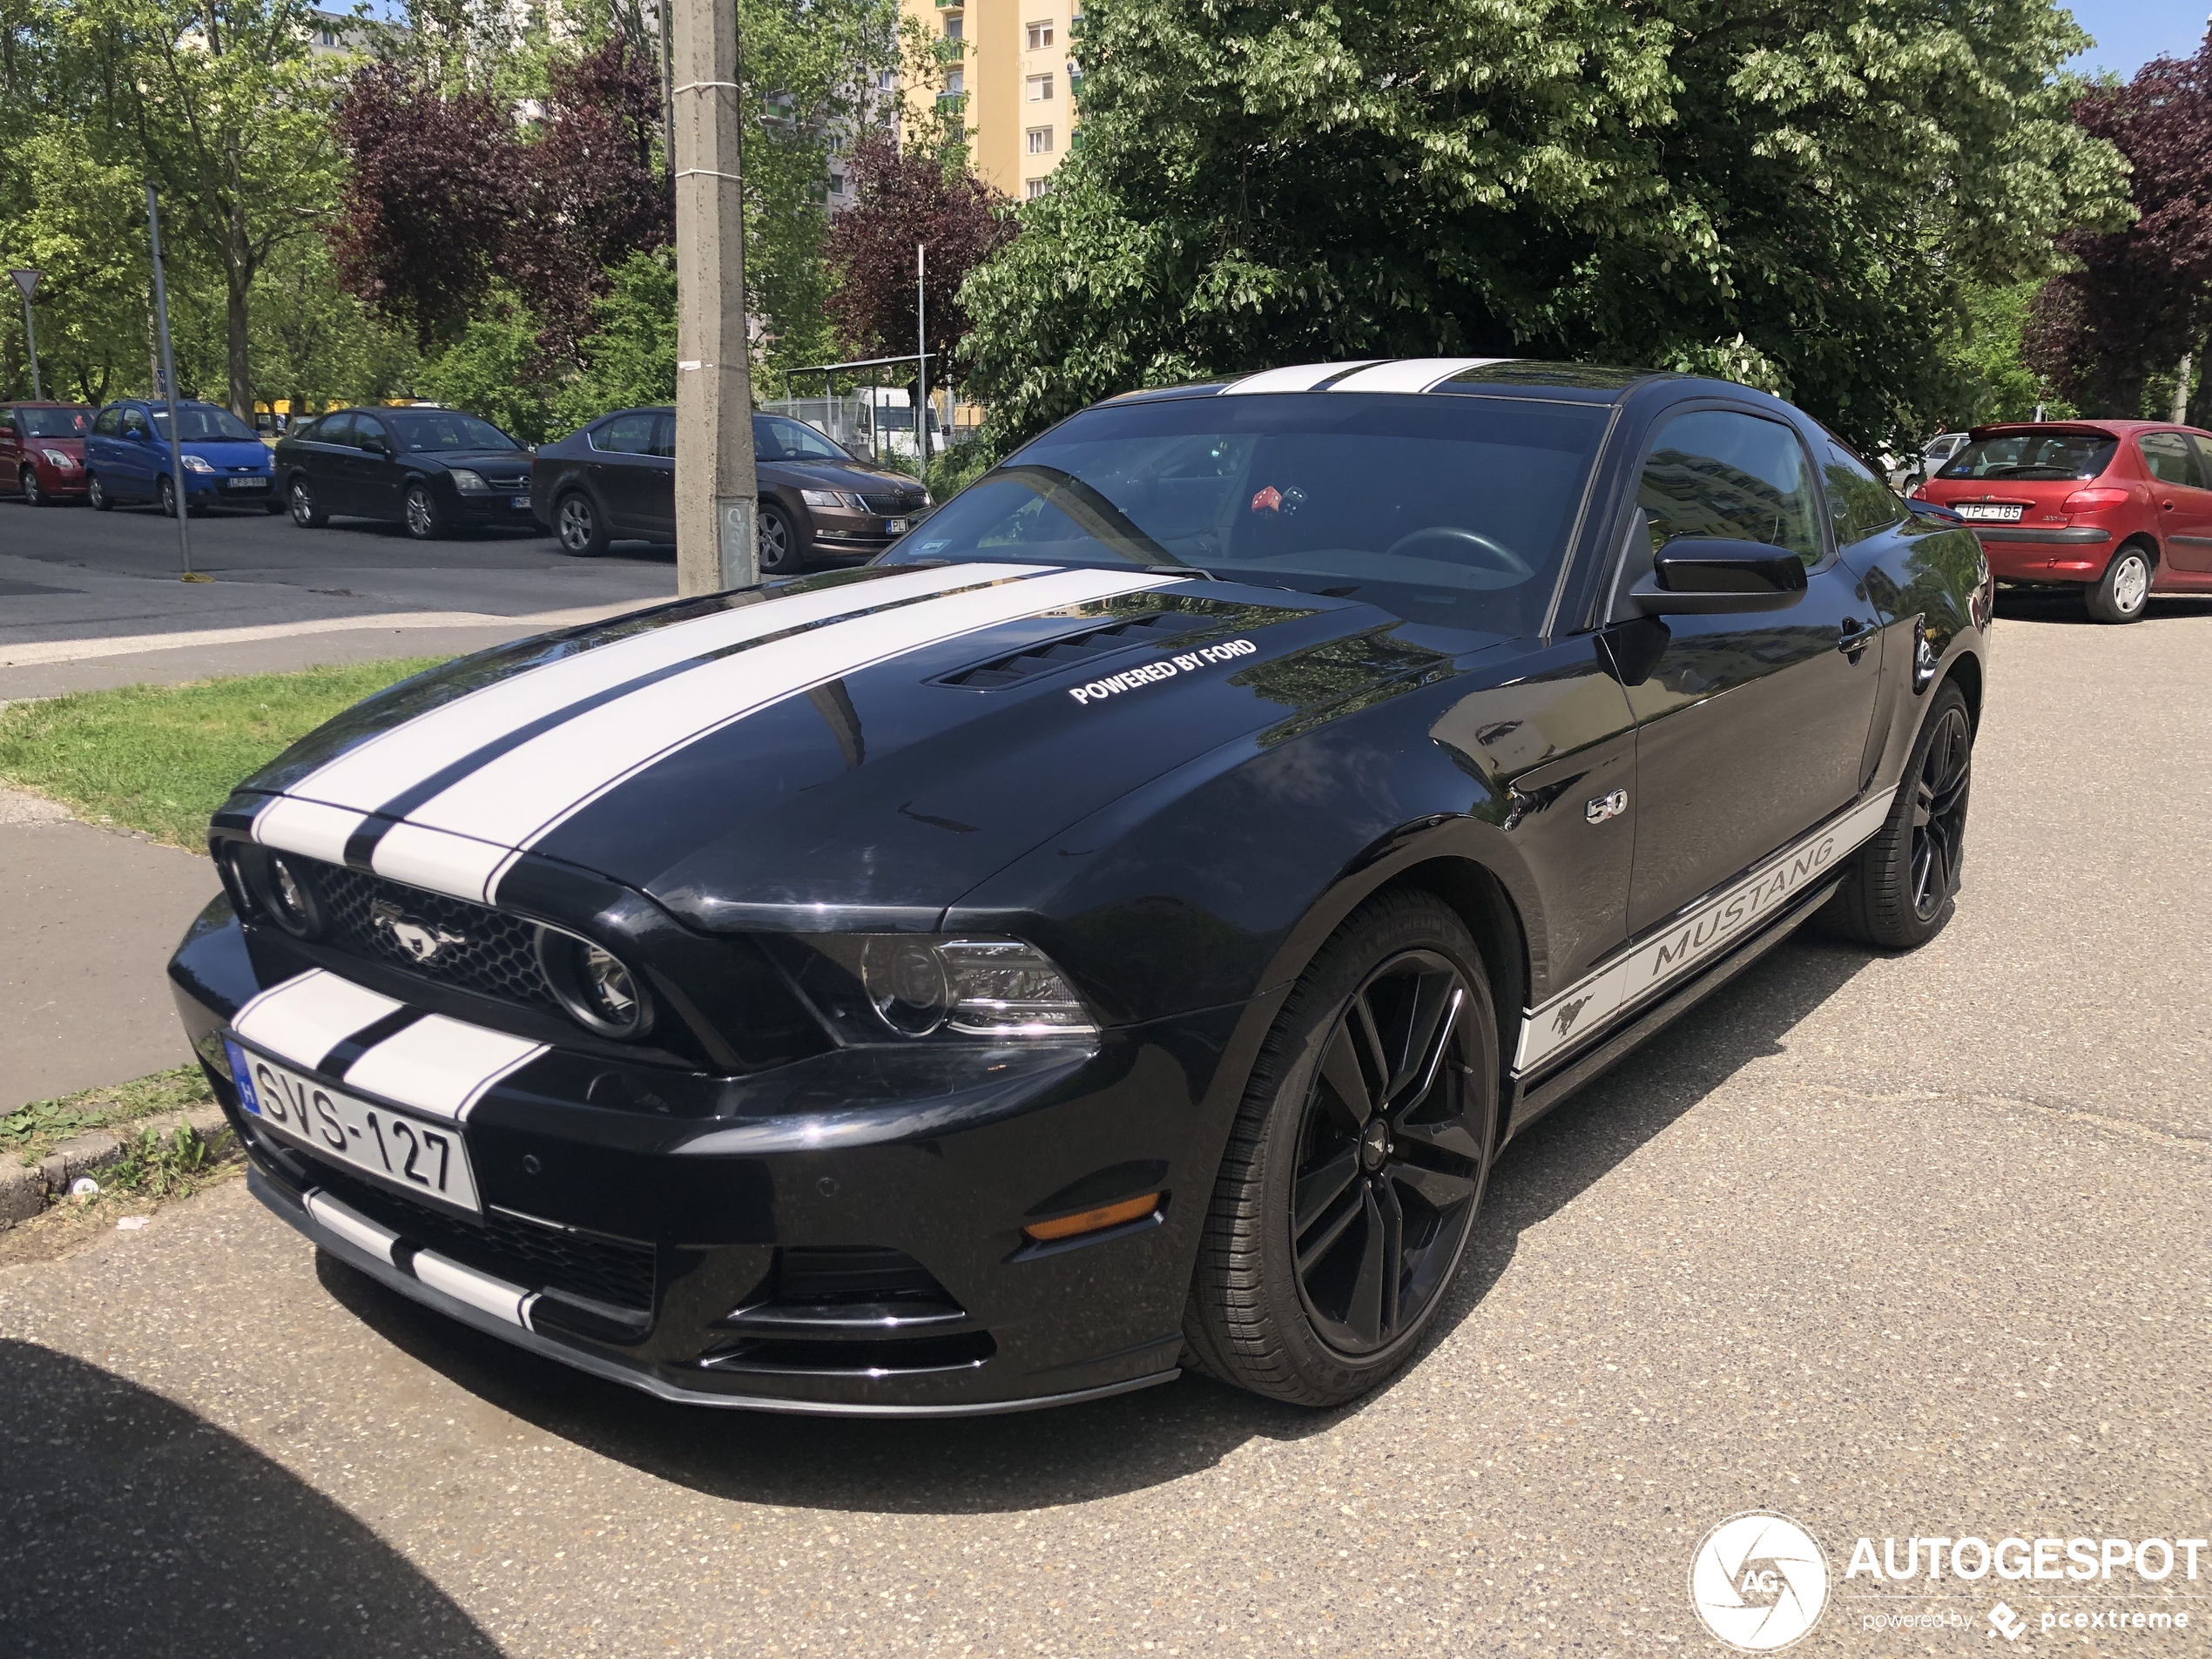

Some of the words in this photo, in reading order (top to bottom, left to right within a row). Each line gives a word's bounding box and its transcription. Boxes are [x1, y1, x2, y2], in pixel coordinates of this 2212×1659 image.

[1966, 505, 2020, 518] IPL-185
[1069, 661, 1178, 705] POWERED
[1171, 651, 1205, 671] BY
[1198, 638, 1258, 664] FORD
[1652, 837, 1834, 976] MUSTANG
[241, 1082, 254, 1103] H
[256, 1062, 449, 1193] SVS-127
